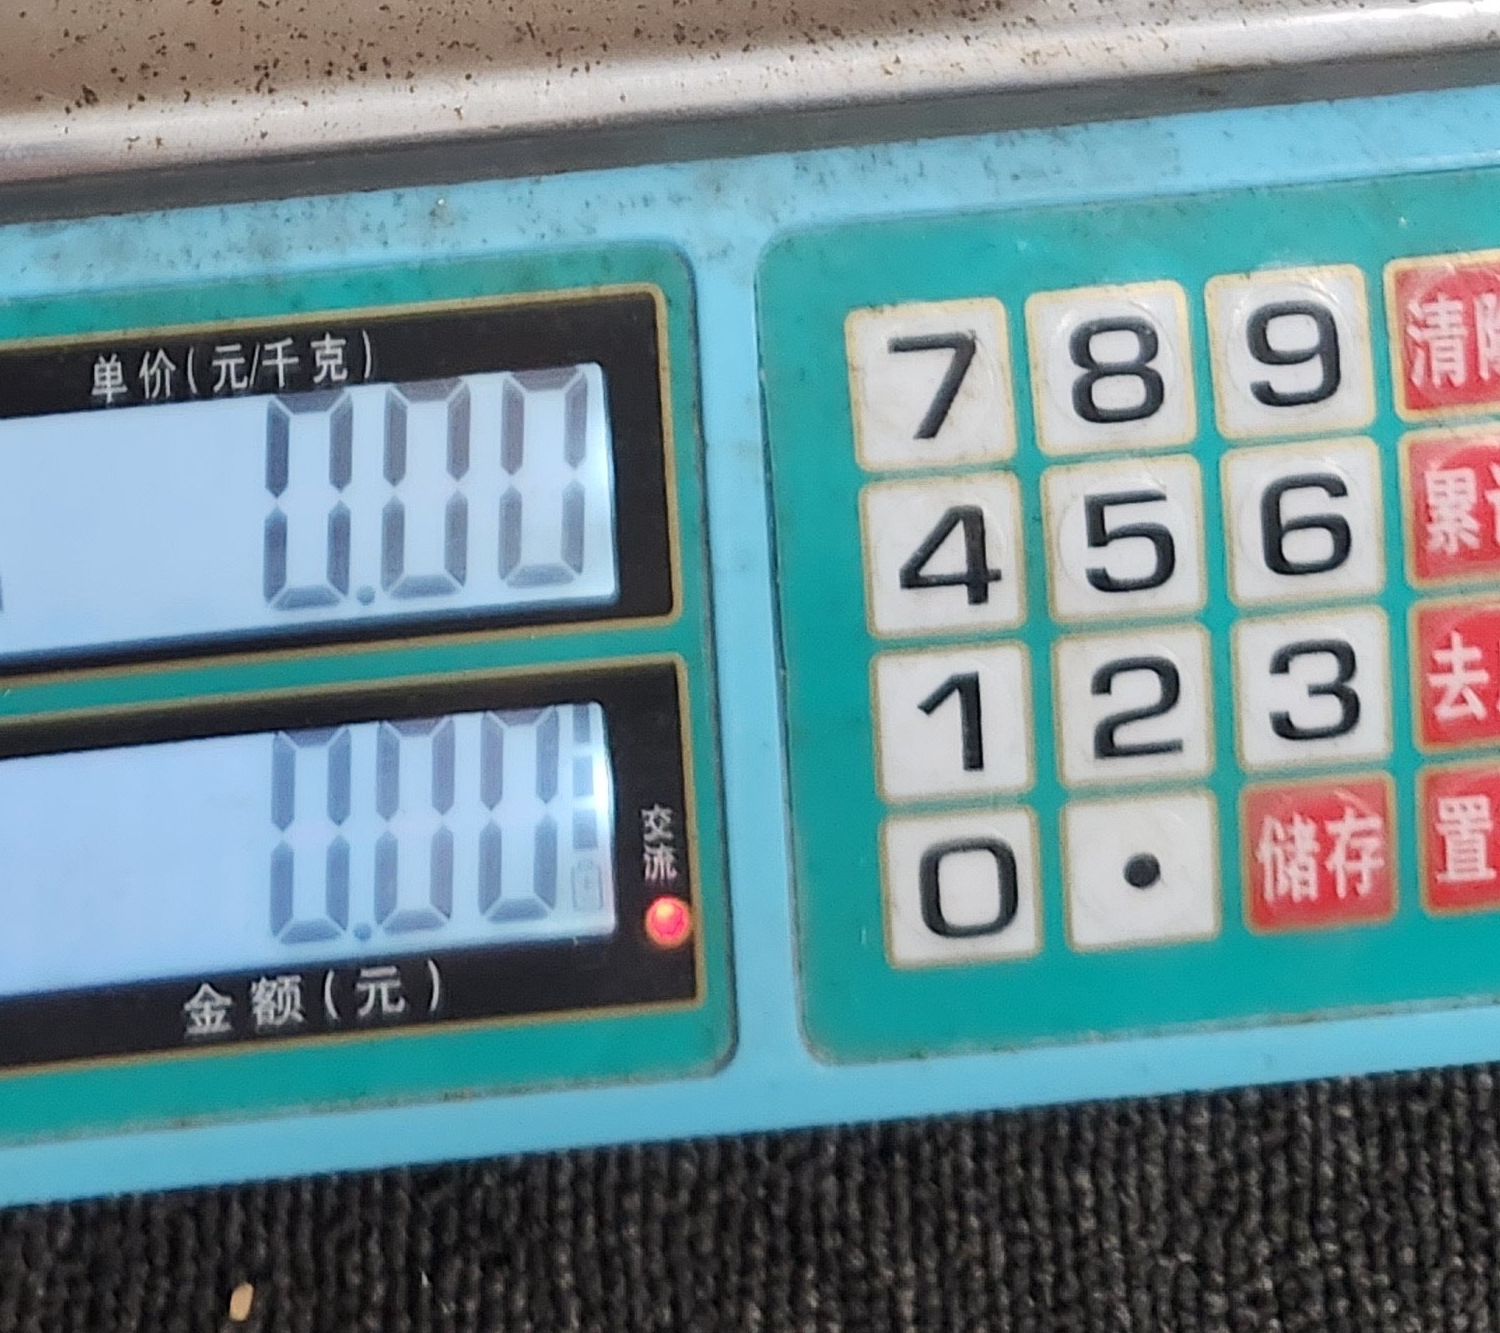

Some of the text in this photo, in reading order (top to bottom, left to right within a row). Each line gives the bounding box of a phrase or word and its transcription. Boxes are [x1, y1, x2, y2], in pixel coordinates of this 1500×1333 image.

[90, 330, 376, 403] 单价(元/千克)
[887, 329, 978, 440] 7
[1068, 315, 1166, 424] 8
[1245, 300, 1342, 408] 9
[898, 503, 1002, 606] 4
[1083, 489, 1176, 593] 5
[1259, 472, 1353, 577] 6
[1424, 462, 1500, 555] 累
[917, 670, 985, 773] 1
[1089, 654, 1185, 760] 2
[1268, 638, 1361, 742] 3
[640, 804, 677, 882] 交流
[917, 836, 1019, 939] 0
[1255, 810, 1387, 904] 储存
[183, 960, 444, 1038] 金额(元)
